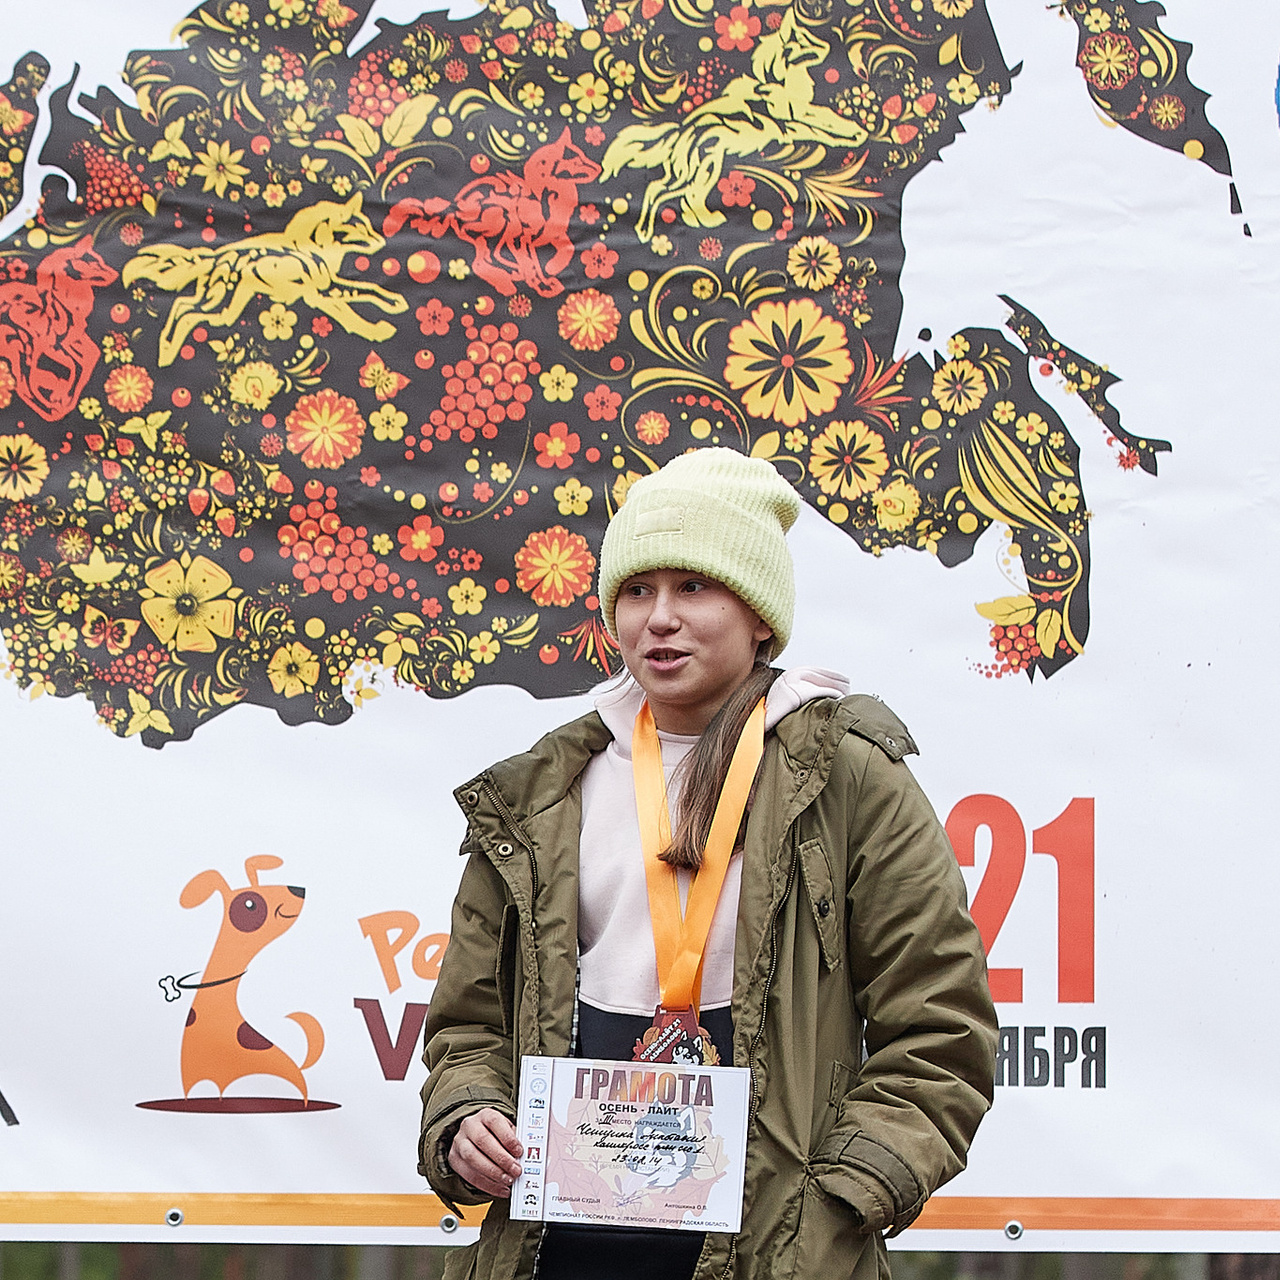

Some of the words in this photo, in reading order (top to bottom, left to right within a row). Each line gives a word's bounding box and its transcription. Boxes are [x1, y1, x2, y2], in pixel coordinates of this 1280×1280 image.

[574, 1068, 714, 1106] ГРАМОТА
[599, 1103, 637, 1113] ОСЕНЬ
[648, 1105, 679, 1116] ЛАЙТ
